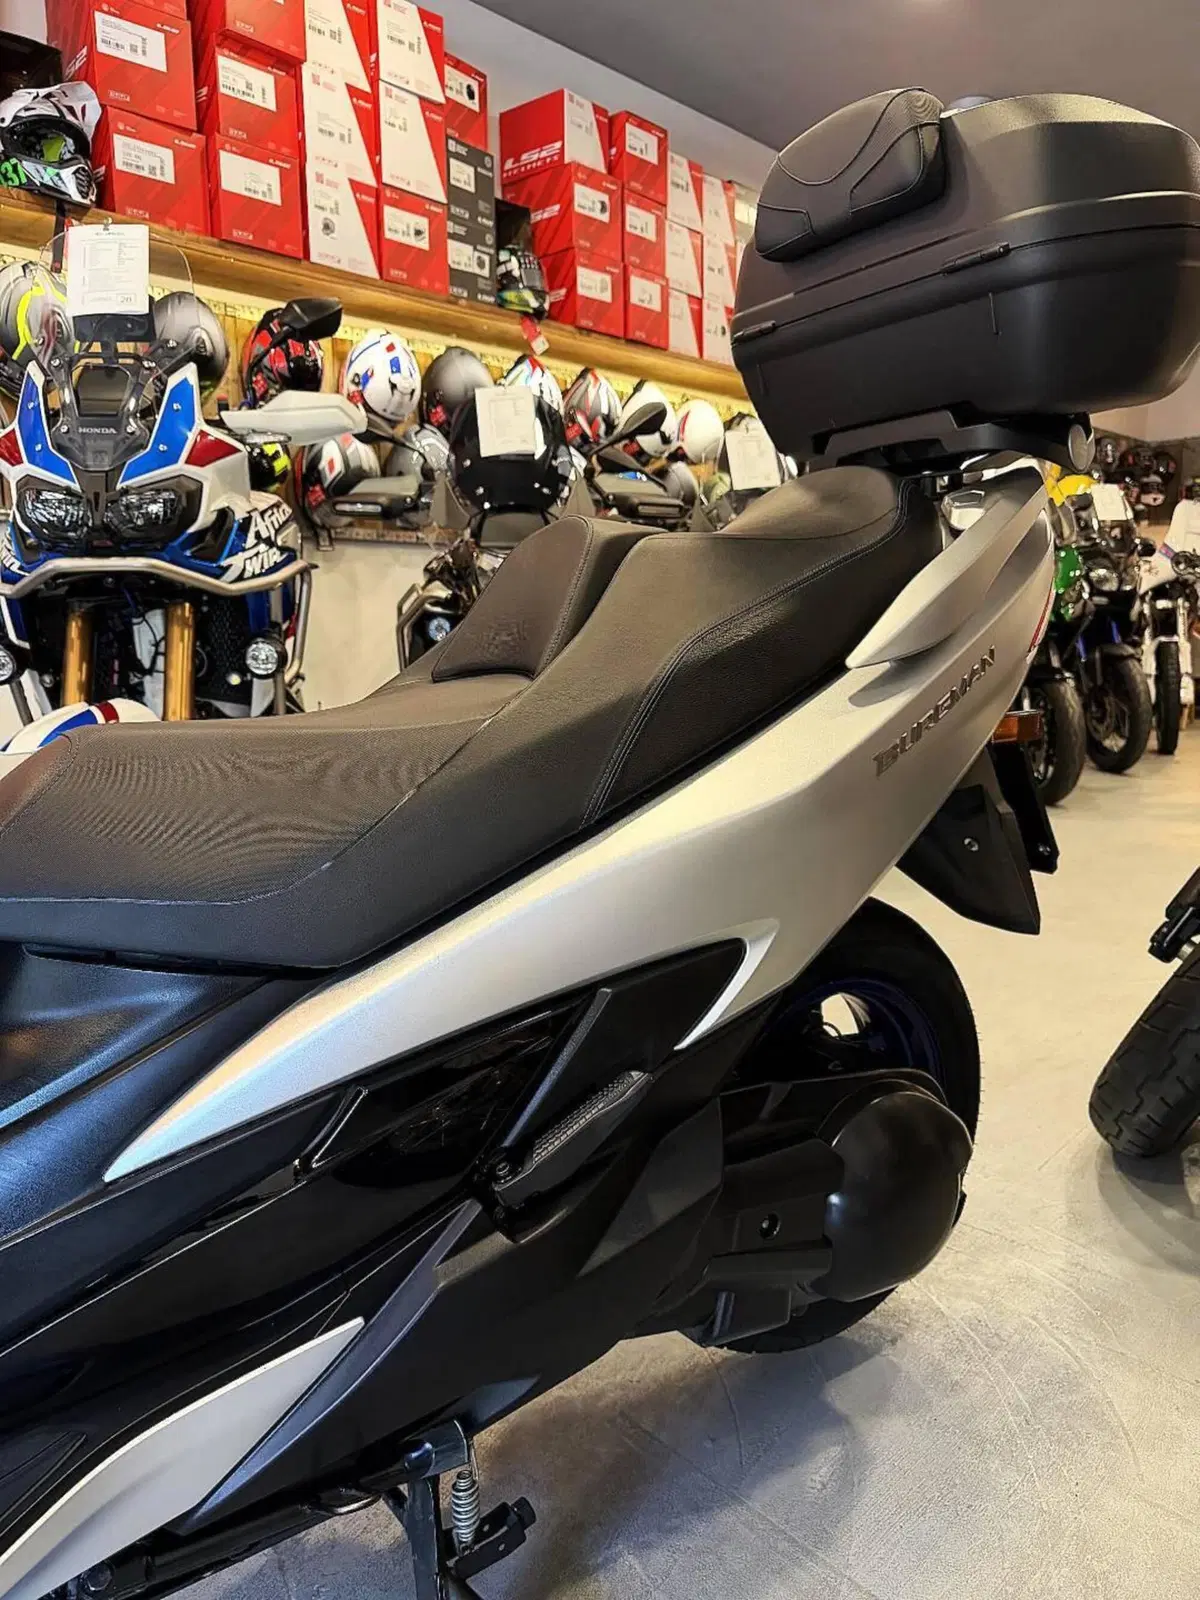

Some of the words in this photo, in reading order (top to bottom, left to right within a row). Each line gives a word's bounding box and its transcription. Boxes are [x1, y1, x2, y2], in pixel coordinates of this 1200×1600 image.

[64, 45, 88, 81] S2
[504, 140, 563, 171] LS2
[0, 157, 28, 186] 37
[530, 204, 561, 224] S2
[78, 426, 117, 434] HONDA
[871, 644, 996, 778] BURGMAN
